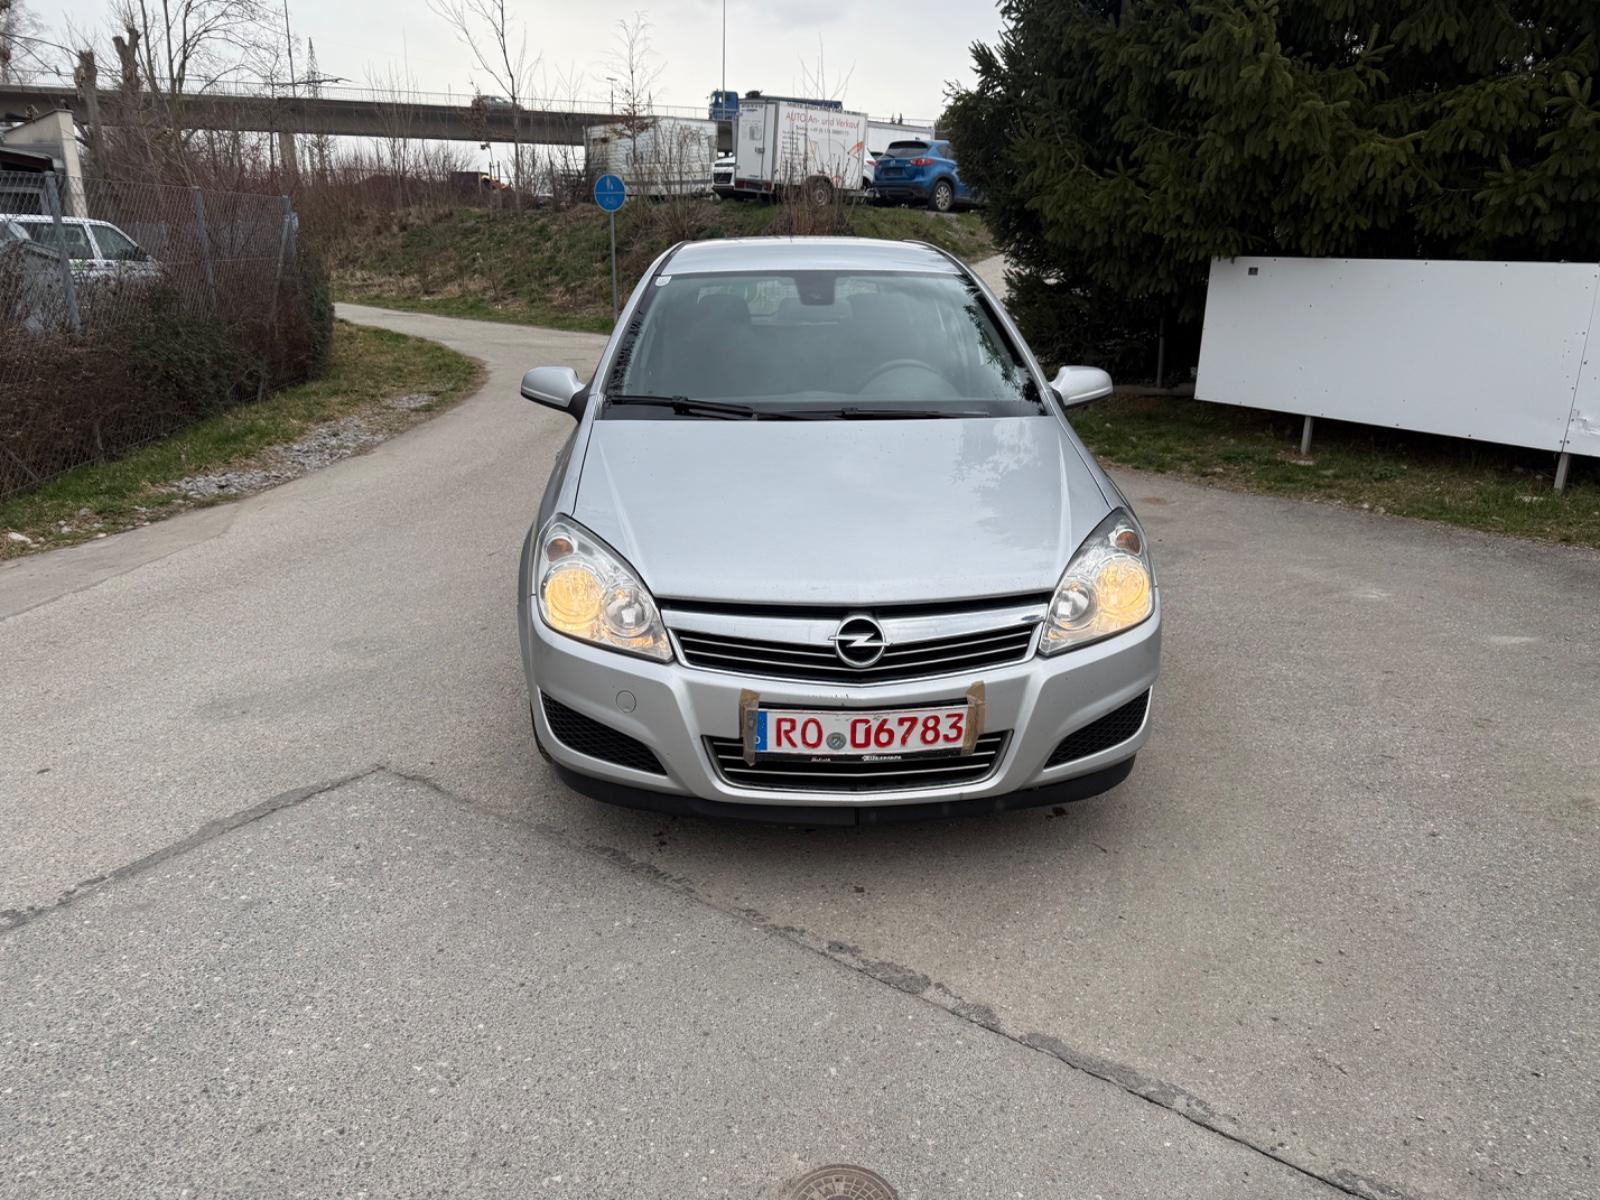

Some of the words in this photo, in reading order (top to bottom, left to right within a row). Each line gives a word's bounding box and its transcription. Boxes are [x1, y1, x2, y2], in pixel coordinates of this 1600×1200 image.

[786, 111, 806, 123] AUTO
[821, 117, 834, 126] und
[776, 717, 823, 749] RO
[850, 712, 964, 749] 06783
